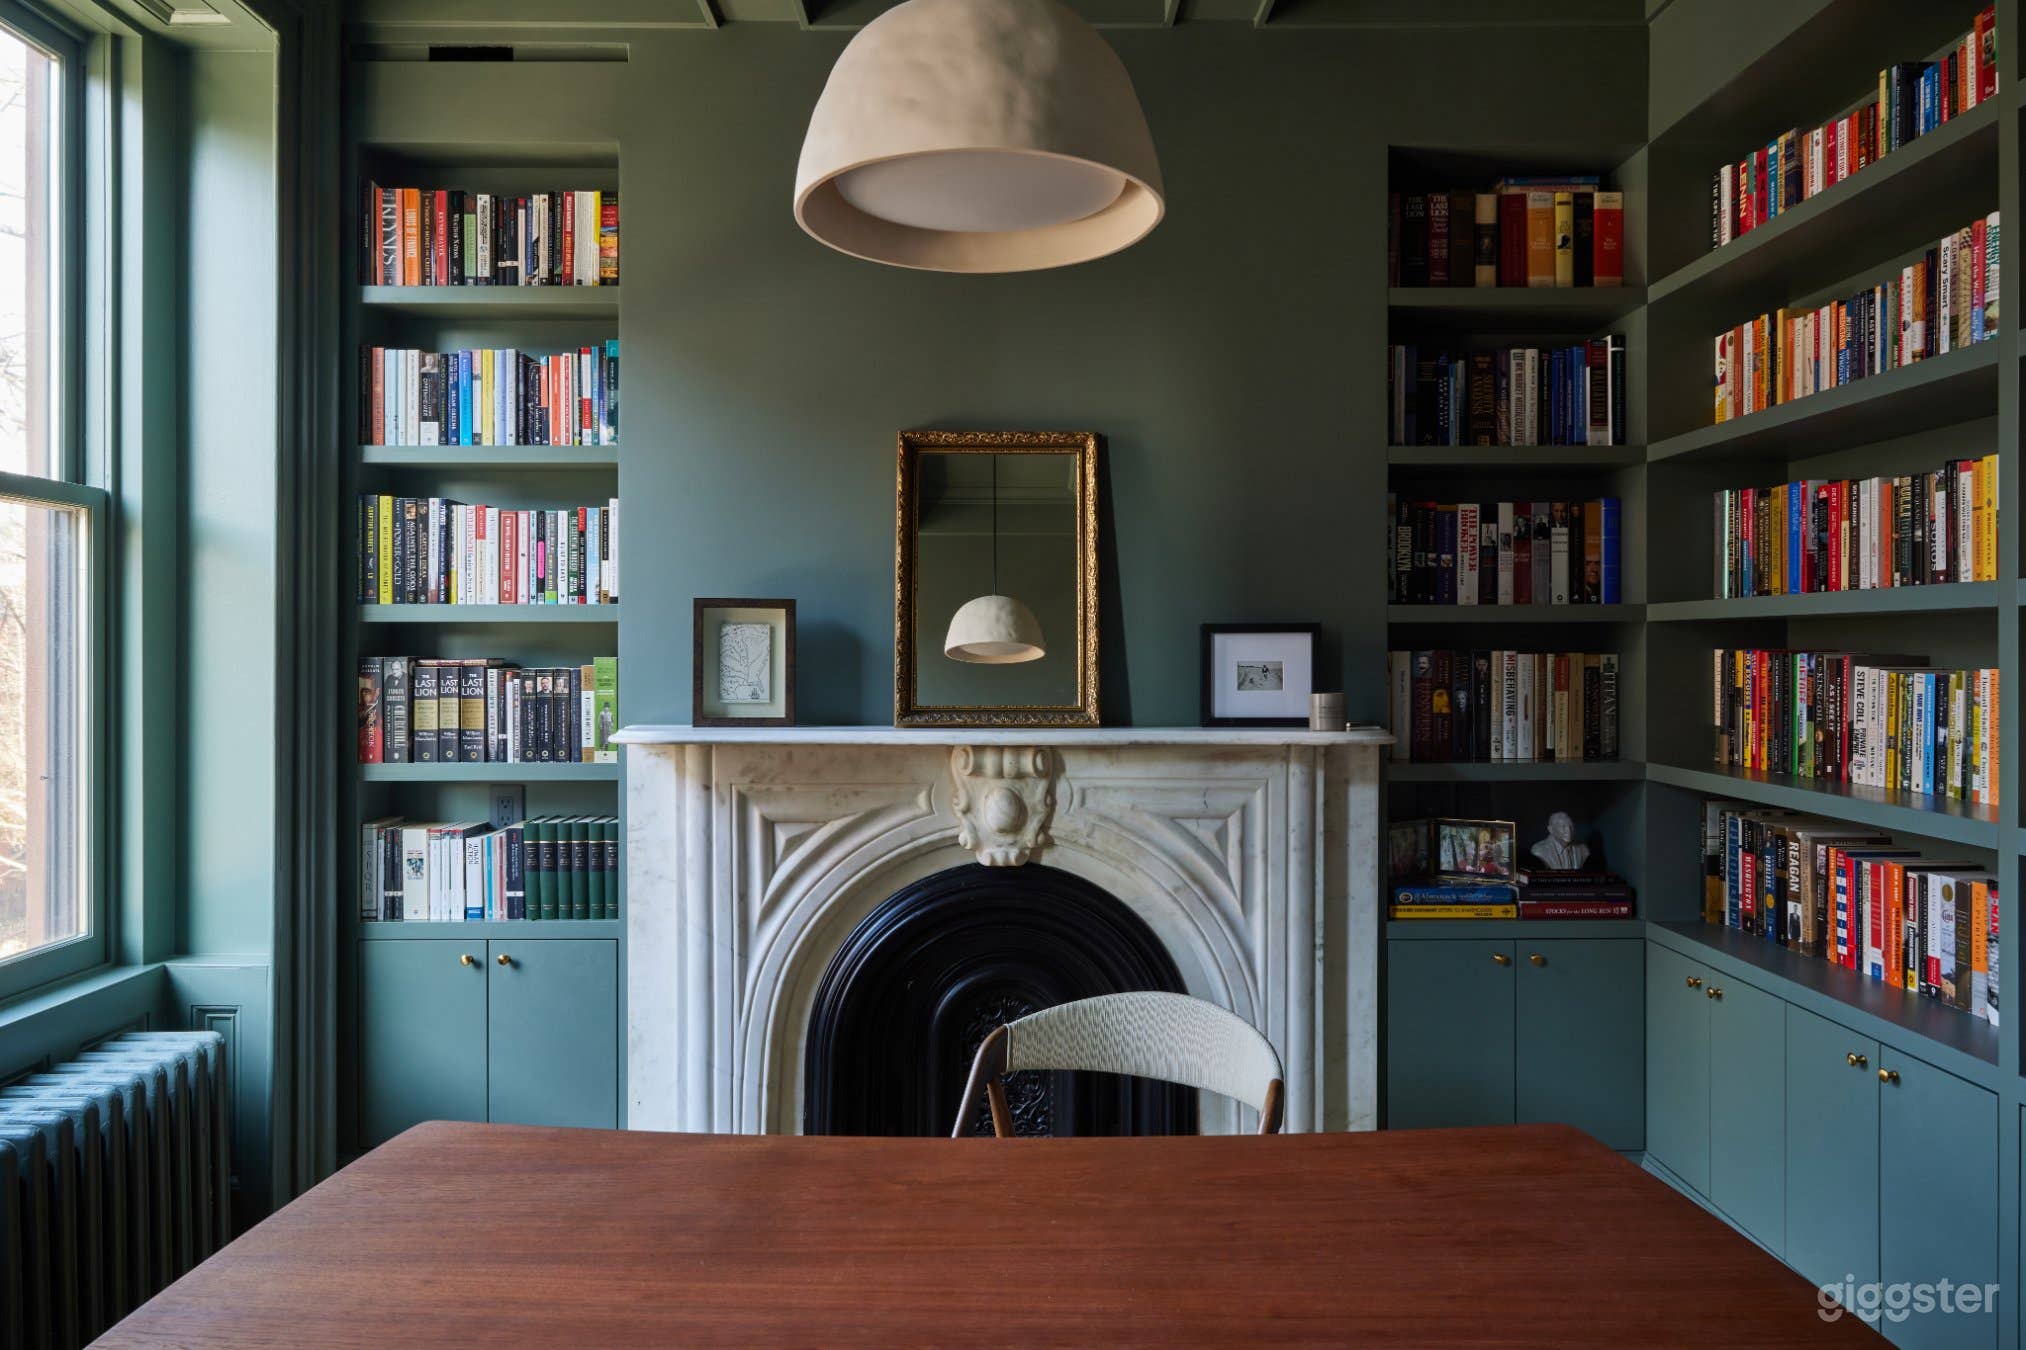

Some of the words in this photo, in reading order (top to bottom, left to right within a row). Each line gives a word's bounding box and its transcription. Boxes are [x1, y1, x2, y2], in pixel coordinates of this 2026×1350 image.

[1739, 162, 1748, 218] LENIN
[382, 203, 397, 266] KEYNES
[1989, 224, 2000, 266] ENERGY
[1941, 246, 1950, 275] Scary
[1972, 246, 1980, 264] How
[1972, 266, 1980, 279] the
[1942, 277, 1950, 310] Smart
[1460, 508, 1469, 554] BROKER
[1468, 507, 1478, 529] THE
[394, 528, 402, 556] POWER
[1396, 525, 1412, 572] BROOKLYN
[1468, 533, 1478, 572] POWER
[1929, 521, 1938, 572] SOROS
[394, 561, 402, 585] GOLD
[414, 679, 437, 688] LAST
[414, 688, 438, 697] LION
[440, 679, 459, 687] LAST
[440, 687, 459, 695] LION
[461, 678, 484, 687] LAST
[461, 687, 484, 697] LION
[1505, 655, 1516, 717] MISBEHAVING
[1603, 671, 1617, 717] TITAN
[1744, 668, 1752, 707] EXCUSES
[1816, 672, 1824, 699] KING
[1829, 683, 1836, 696] AS
[1856, 671, 1866, 699] STEVE
[1981, 677, 1990, 708] Howard
[366, 700, 379, 748] NAPOLEON
[393, 704, 406, 750] CHURCHILL
[1816, 704, 1824, 723] OIL
[1829, 722, 1835, 733] IT
[1855, 704, 1866, 725] COLL
[1859, 728, 1867, 758] PRIVATE
[1788, 841, 1801, 893] REAGAN
[1744, 855, 1754, 910] WASHINGTON
[1580, 906, 1598, 915] LONG
[1598, 906, 1612, 914] RUN
